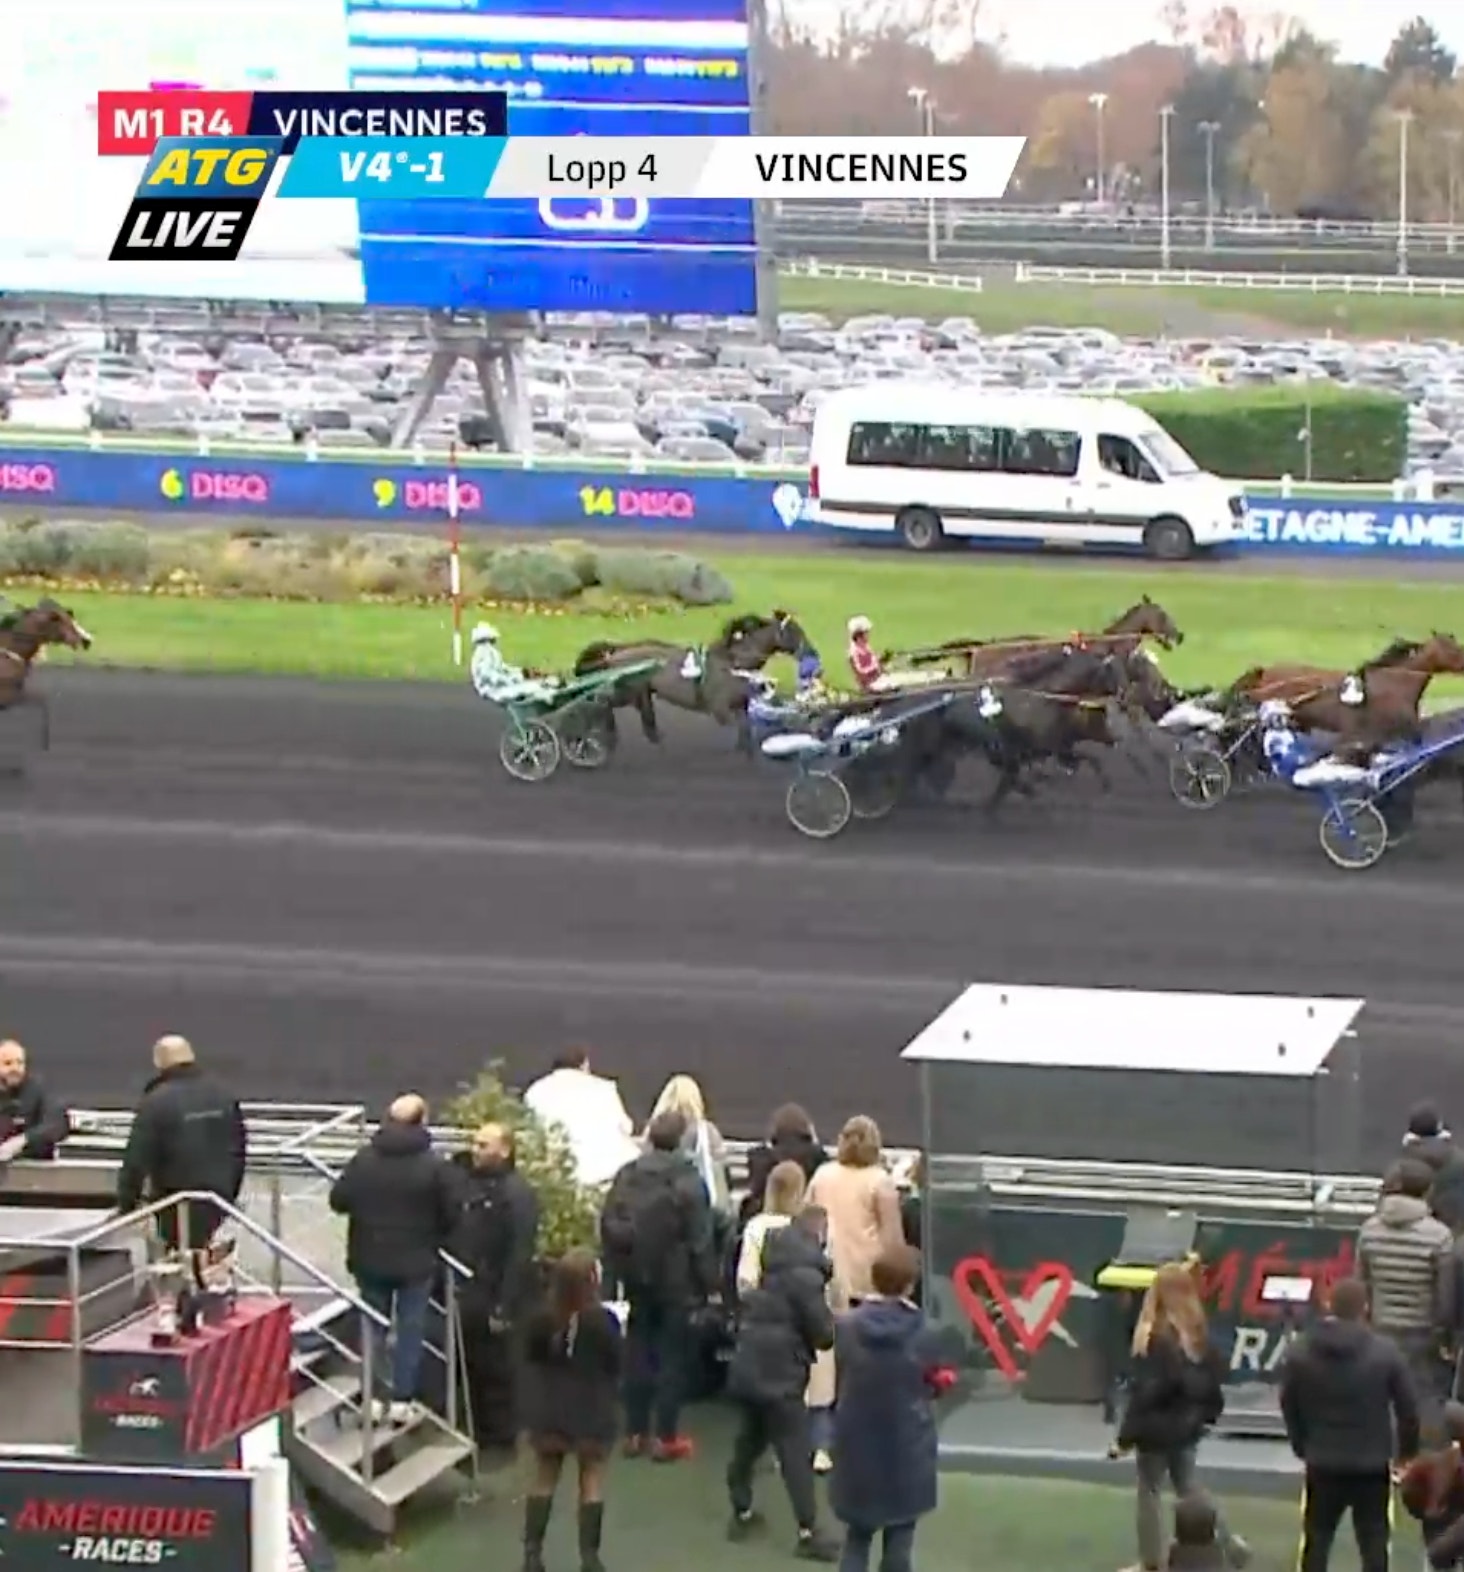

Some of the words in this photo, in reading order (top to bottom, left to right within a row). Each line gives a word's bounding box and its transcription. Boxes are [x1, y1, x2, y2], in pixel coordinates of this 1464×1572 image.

[0, 464, 54, 491] ISQ
[160, 468, 184, 499] 6
[192, 472, 269, 501] DISQ
[373, 479, 397, 508] 9
[405, 481, 481, 511] DISQ
[580, 485, 617, 516] 14
[618, 489, 695, 518] DISQ
